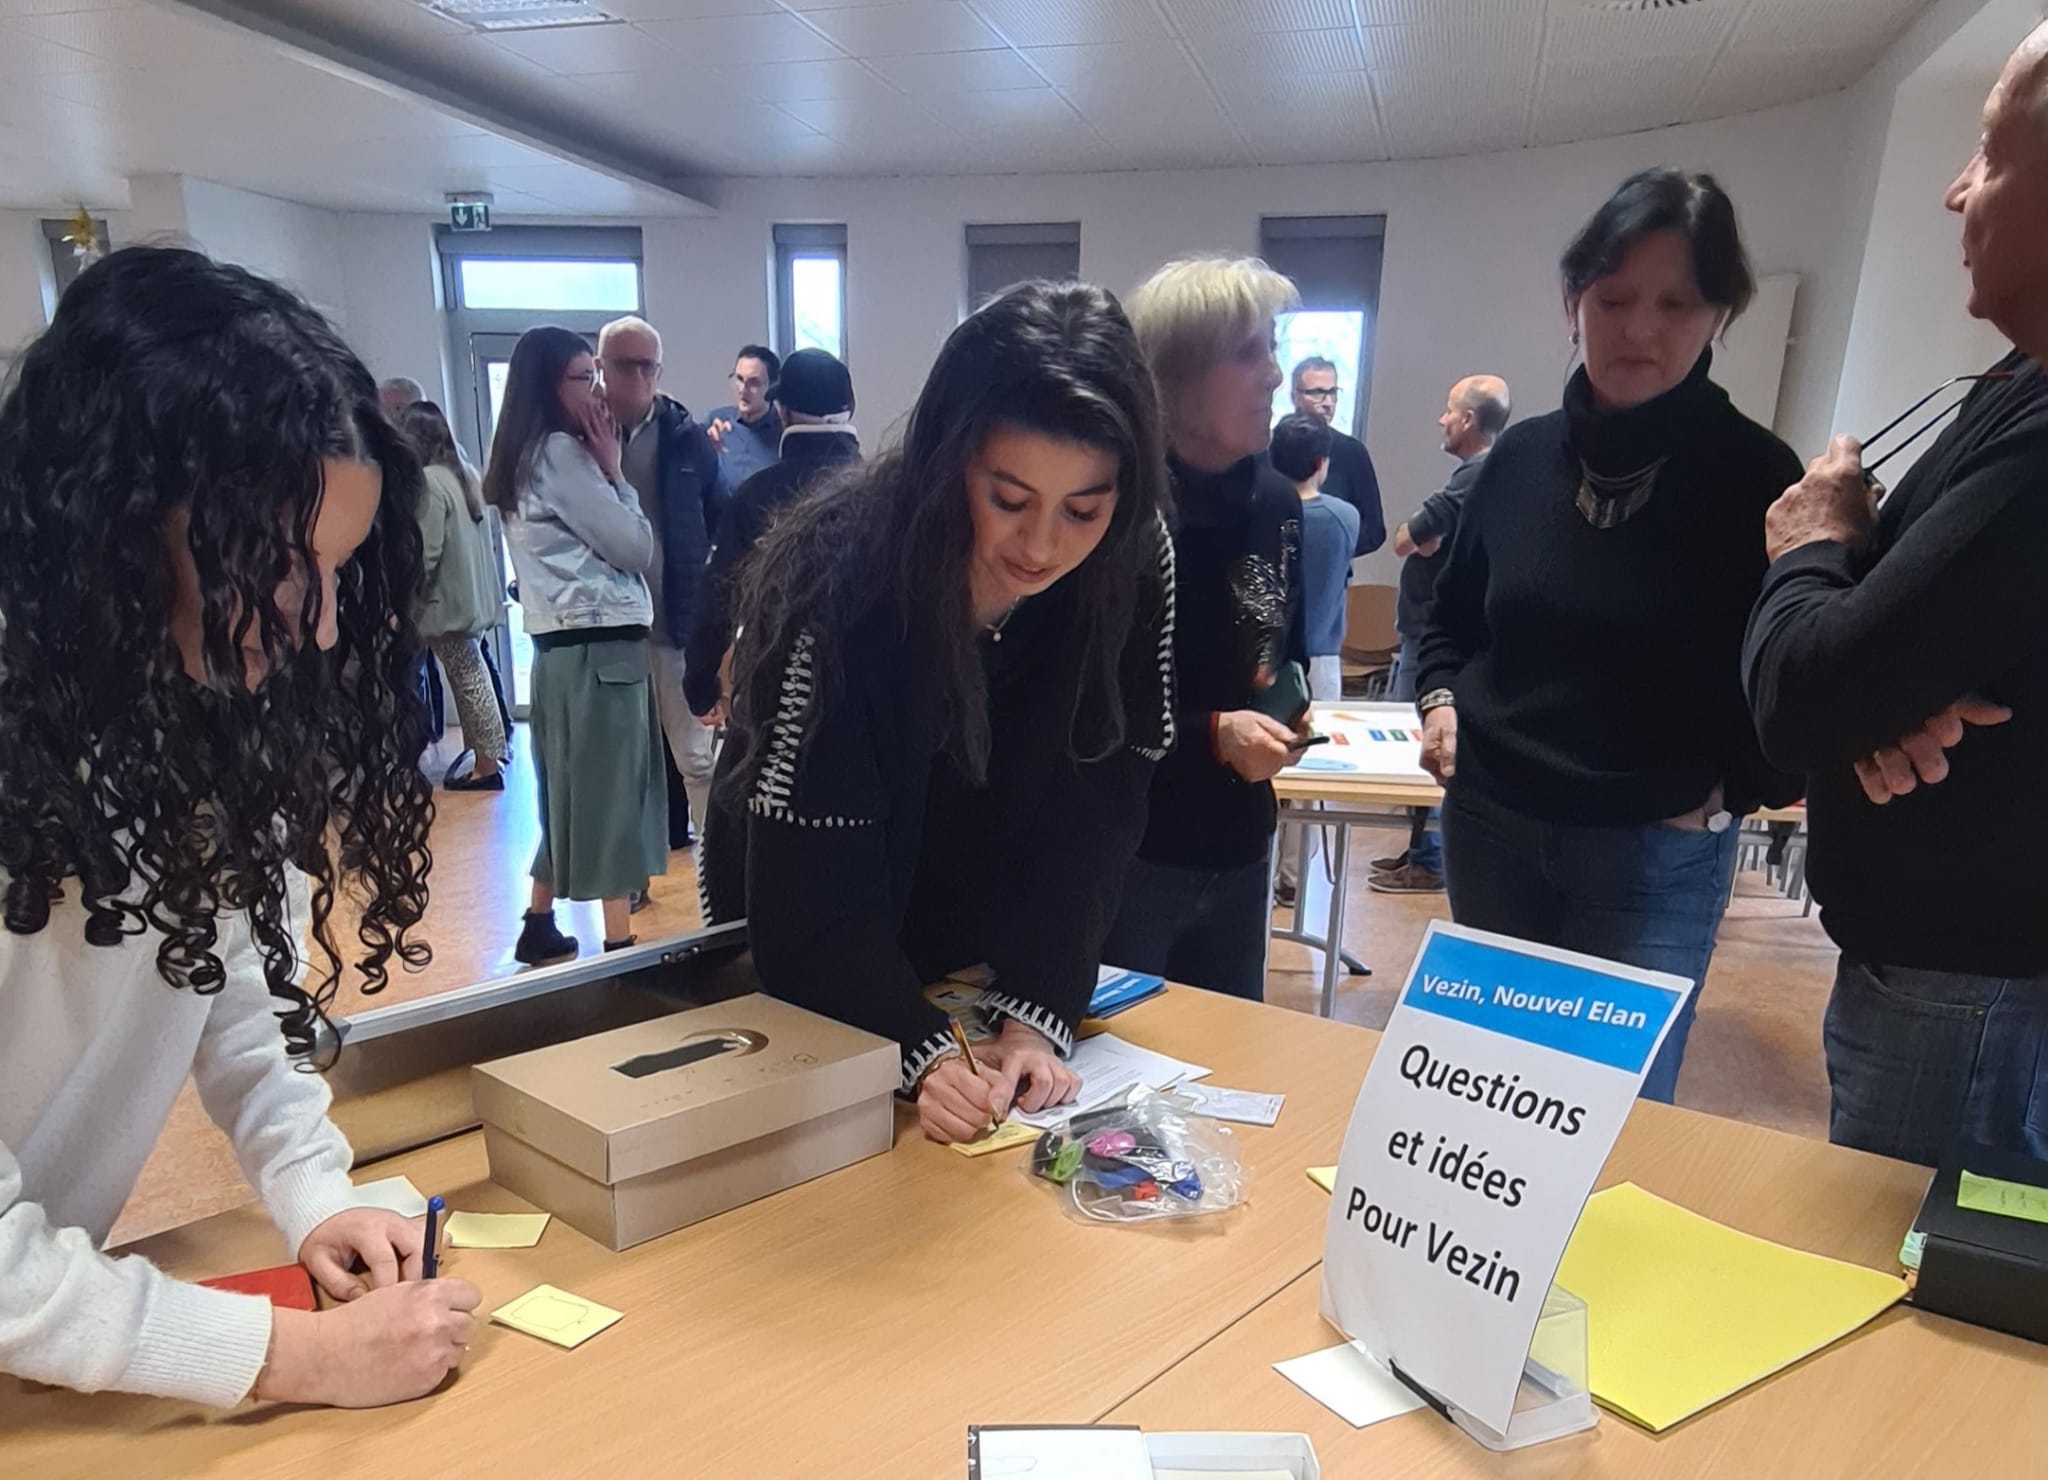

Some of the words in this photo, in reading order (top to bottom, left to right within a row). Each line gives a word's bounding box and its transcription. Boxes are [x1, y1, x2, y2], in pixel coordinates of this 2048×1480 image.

[1422, 974, 1485, 1004] Vezin,
[1493, 984, 1582, 1018] Nouvel
[1587, 1001, 1647, 1029] Elan
[1400, 1045, 1586, 1136] Questions
[1388, 1130, 1424, 1167] et
[1428, 1137, 1527, 1207] idées
[1346, 1186, 1418, 1250] Pour
[1427, 1222, 1520, 1302] Vezin
